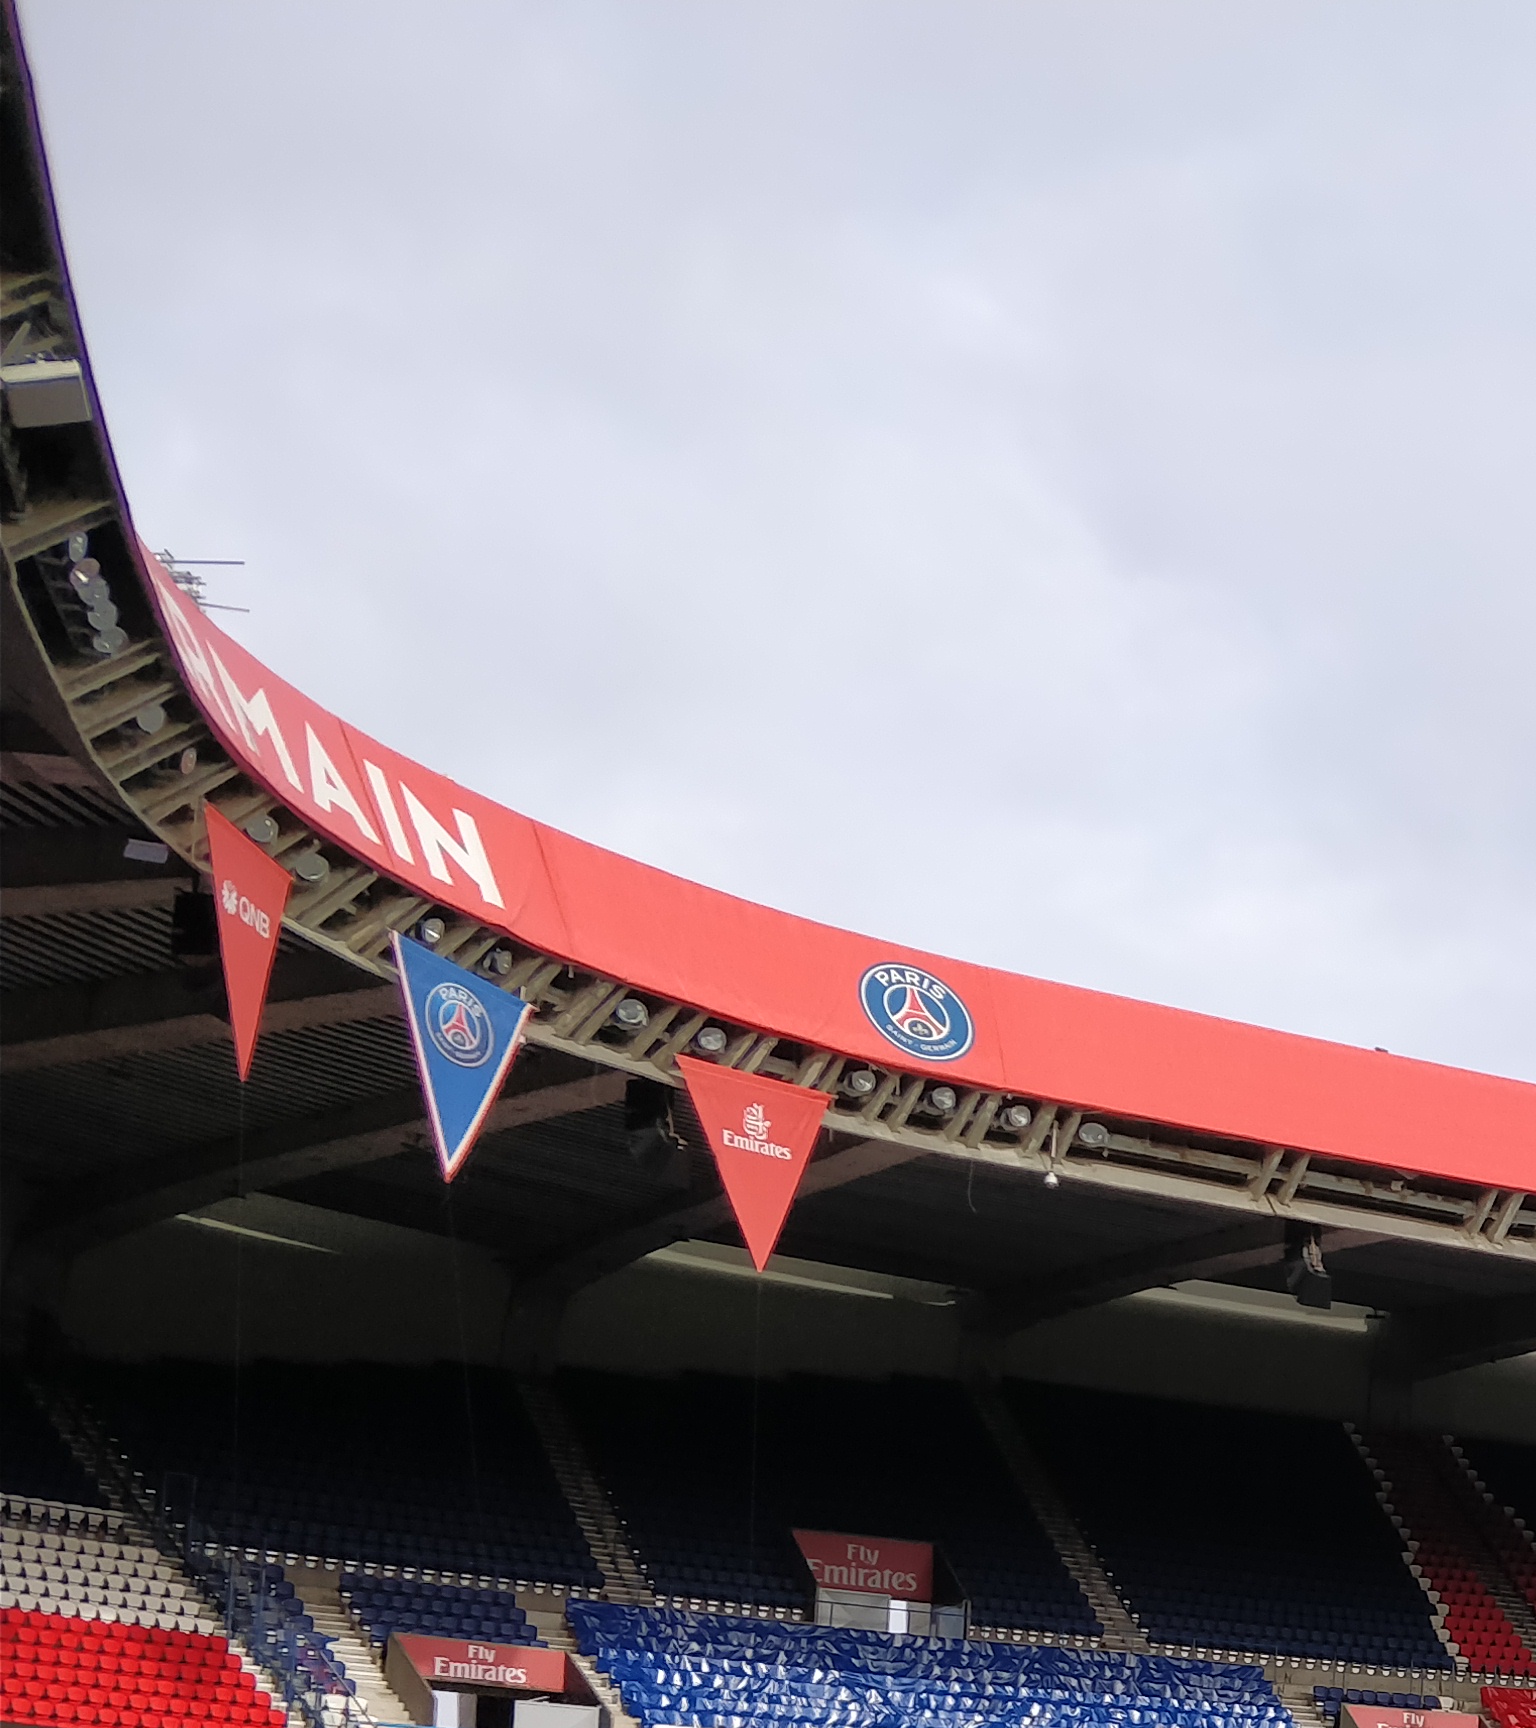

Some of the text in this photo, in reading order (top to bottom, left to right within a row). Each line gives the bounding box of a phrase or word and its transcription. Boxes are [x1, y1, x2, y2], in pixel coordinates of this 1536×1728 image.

[239, 896, 270, 938] QNB
[874, 967, 946, 1000] PARIS
[440, 986, 484, 1018] PARIS
[721, 1128, 792, 1161] Emirates
[847, 1543, 879, 1565] Fly
[806, 1559, 917, 1592] Emirates
[468, 1644, 496, 1662] Fly
[434, 1656, 527, 1684] Emirates
[1403, 1712, 1424, 1727] Fly
